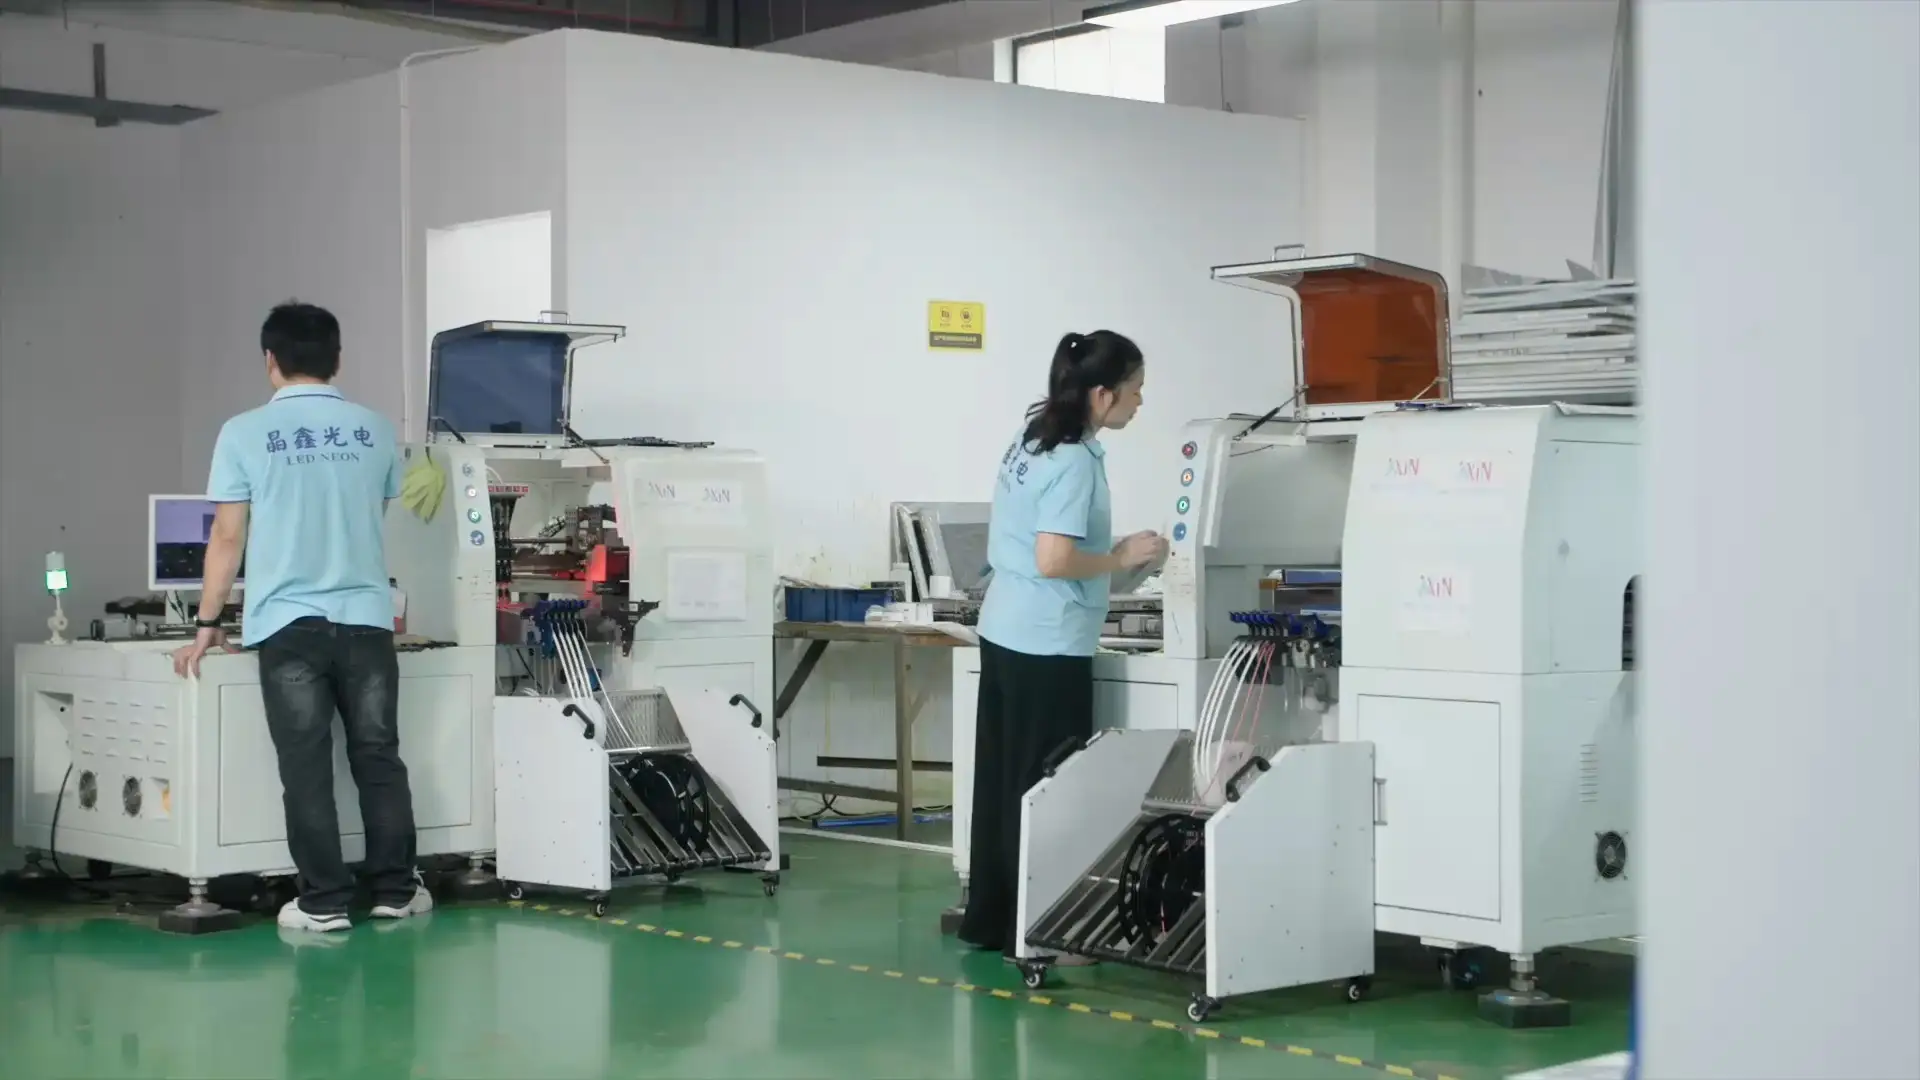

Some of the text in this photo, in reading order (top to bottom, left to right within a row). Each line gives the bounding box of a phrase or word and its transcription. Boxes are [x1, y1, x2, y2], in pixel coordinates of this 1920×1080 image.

[266, 426, 374, 453] 晶鑫光电
[286, 452, 360, 466] LED NEON
